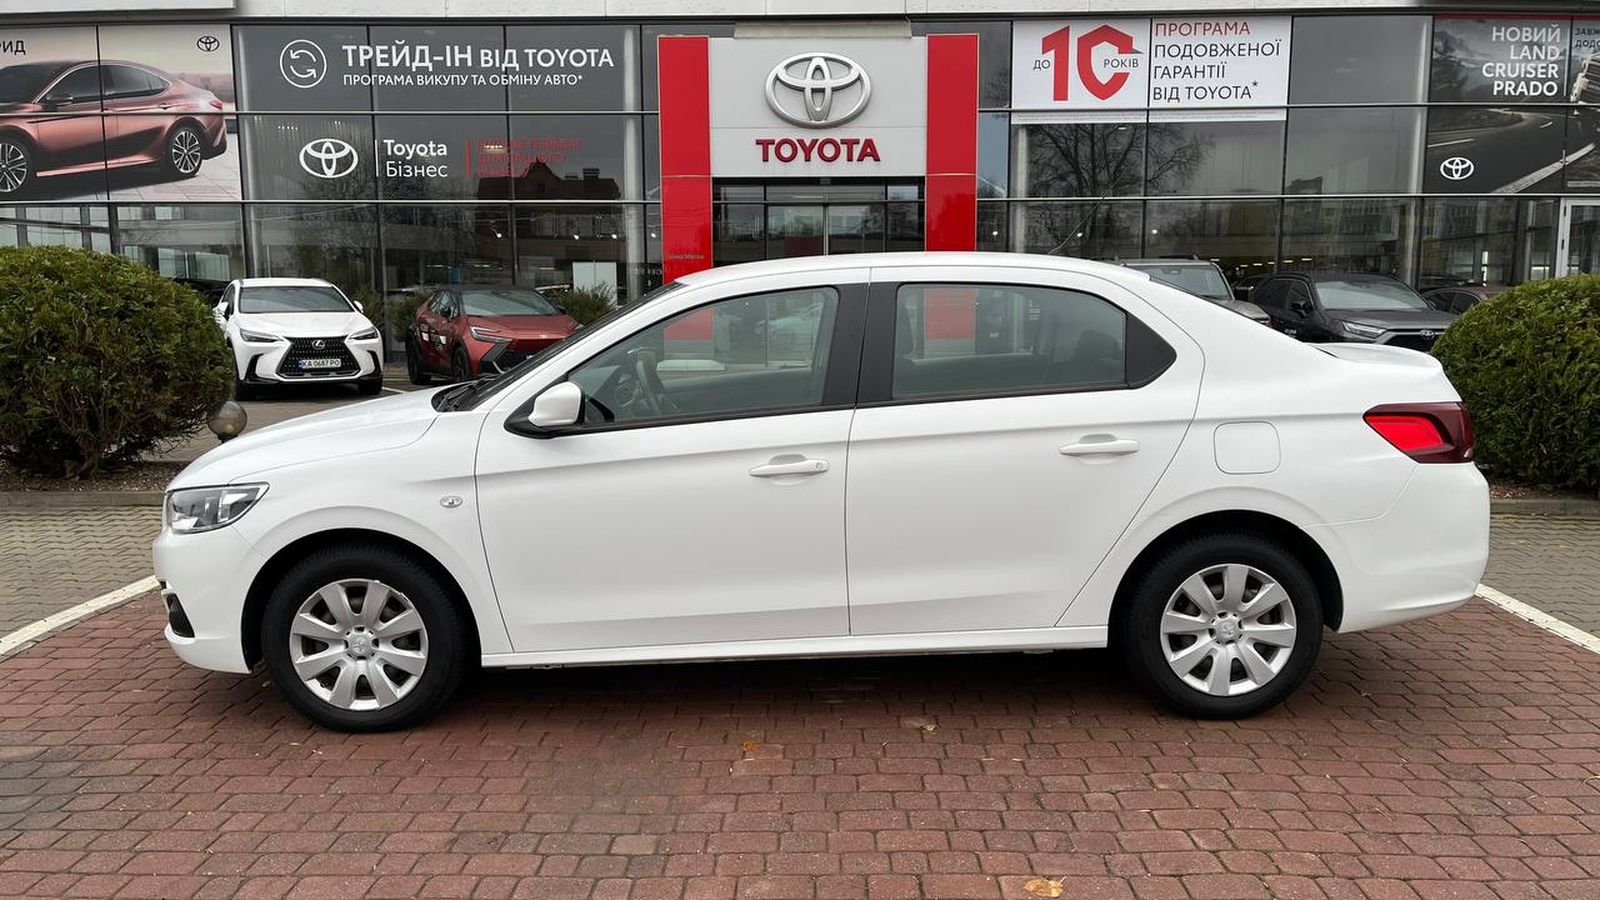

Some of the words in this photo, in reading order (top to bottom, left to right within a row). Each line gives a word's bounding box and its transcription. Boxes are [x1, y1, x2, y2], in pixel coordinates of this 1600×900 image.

[1155, 21, 1251, 37] ПРОГРАМА
[1492, 24, 1561, 43] НОВИЙ
[0, 40, 26, 55] ИД
[342, 40, 472, 71] ТРЕЙД-ІН
[480, 49, 519, 71] ВІД
[524, 49, 614, 67] TOYOTA
[1154, 39, 1282, 61] ПОДОВЖЕНОЇ
[1510, 46, 1560, 60] LAND
[1033, 59, 1051, 70] ДО
[1103, 58, 1139, 69] РОКІВ
[1153, 61, 1227, 80] ГАРАНТІЇ
[1482, 62, 1559, 79] CRUISER
[343, 75, 414, 86] ПРОГРАМА
[416, 75, 469, 86] ВИКУПУ
[470, 75, 486, 85] ТА
[489, 75, 541, 85] ОБМІНУ
[1153, 87, 1181, 103] ВІД
[1493, 81, 1558, 97] PRADO
[383, 140, 447, 159] Toyota
[756, 138, 880, 162] TOYOTA
[386, 161, 448, 177] Бізнес
